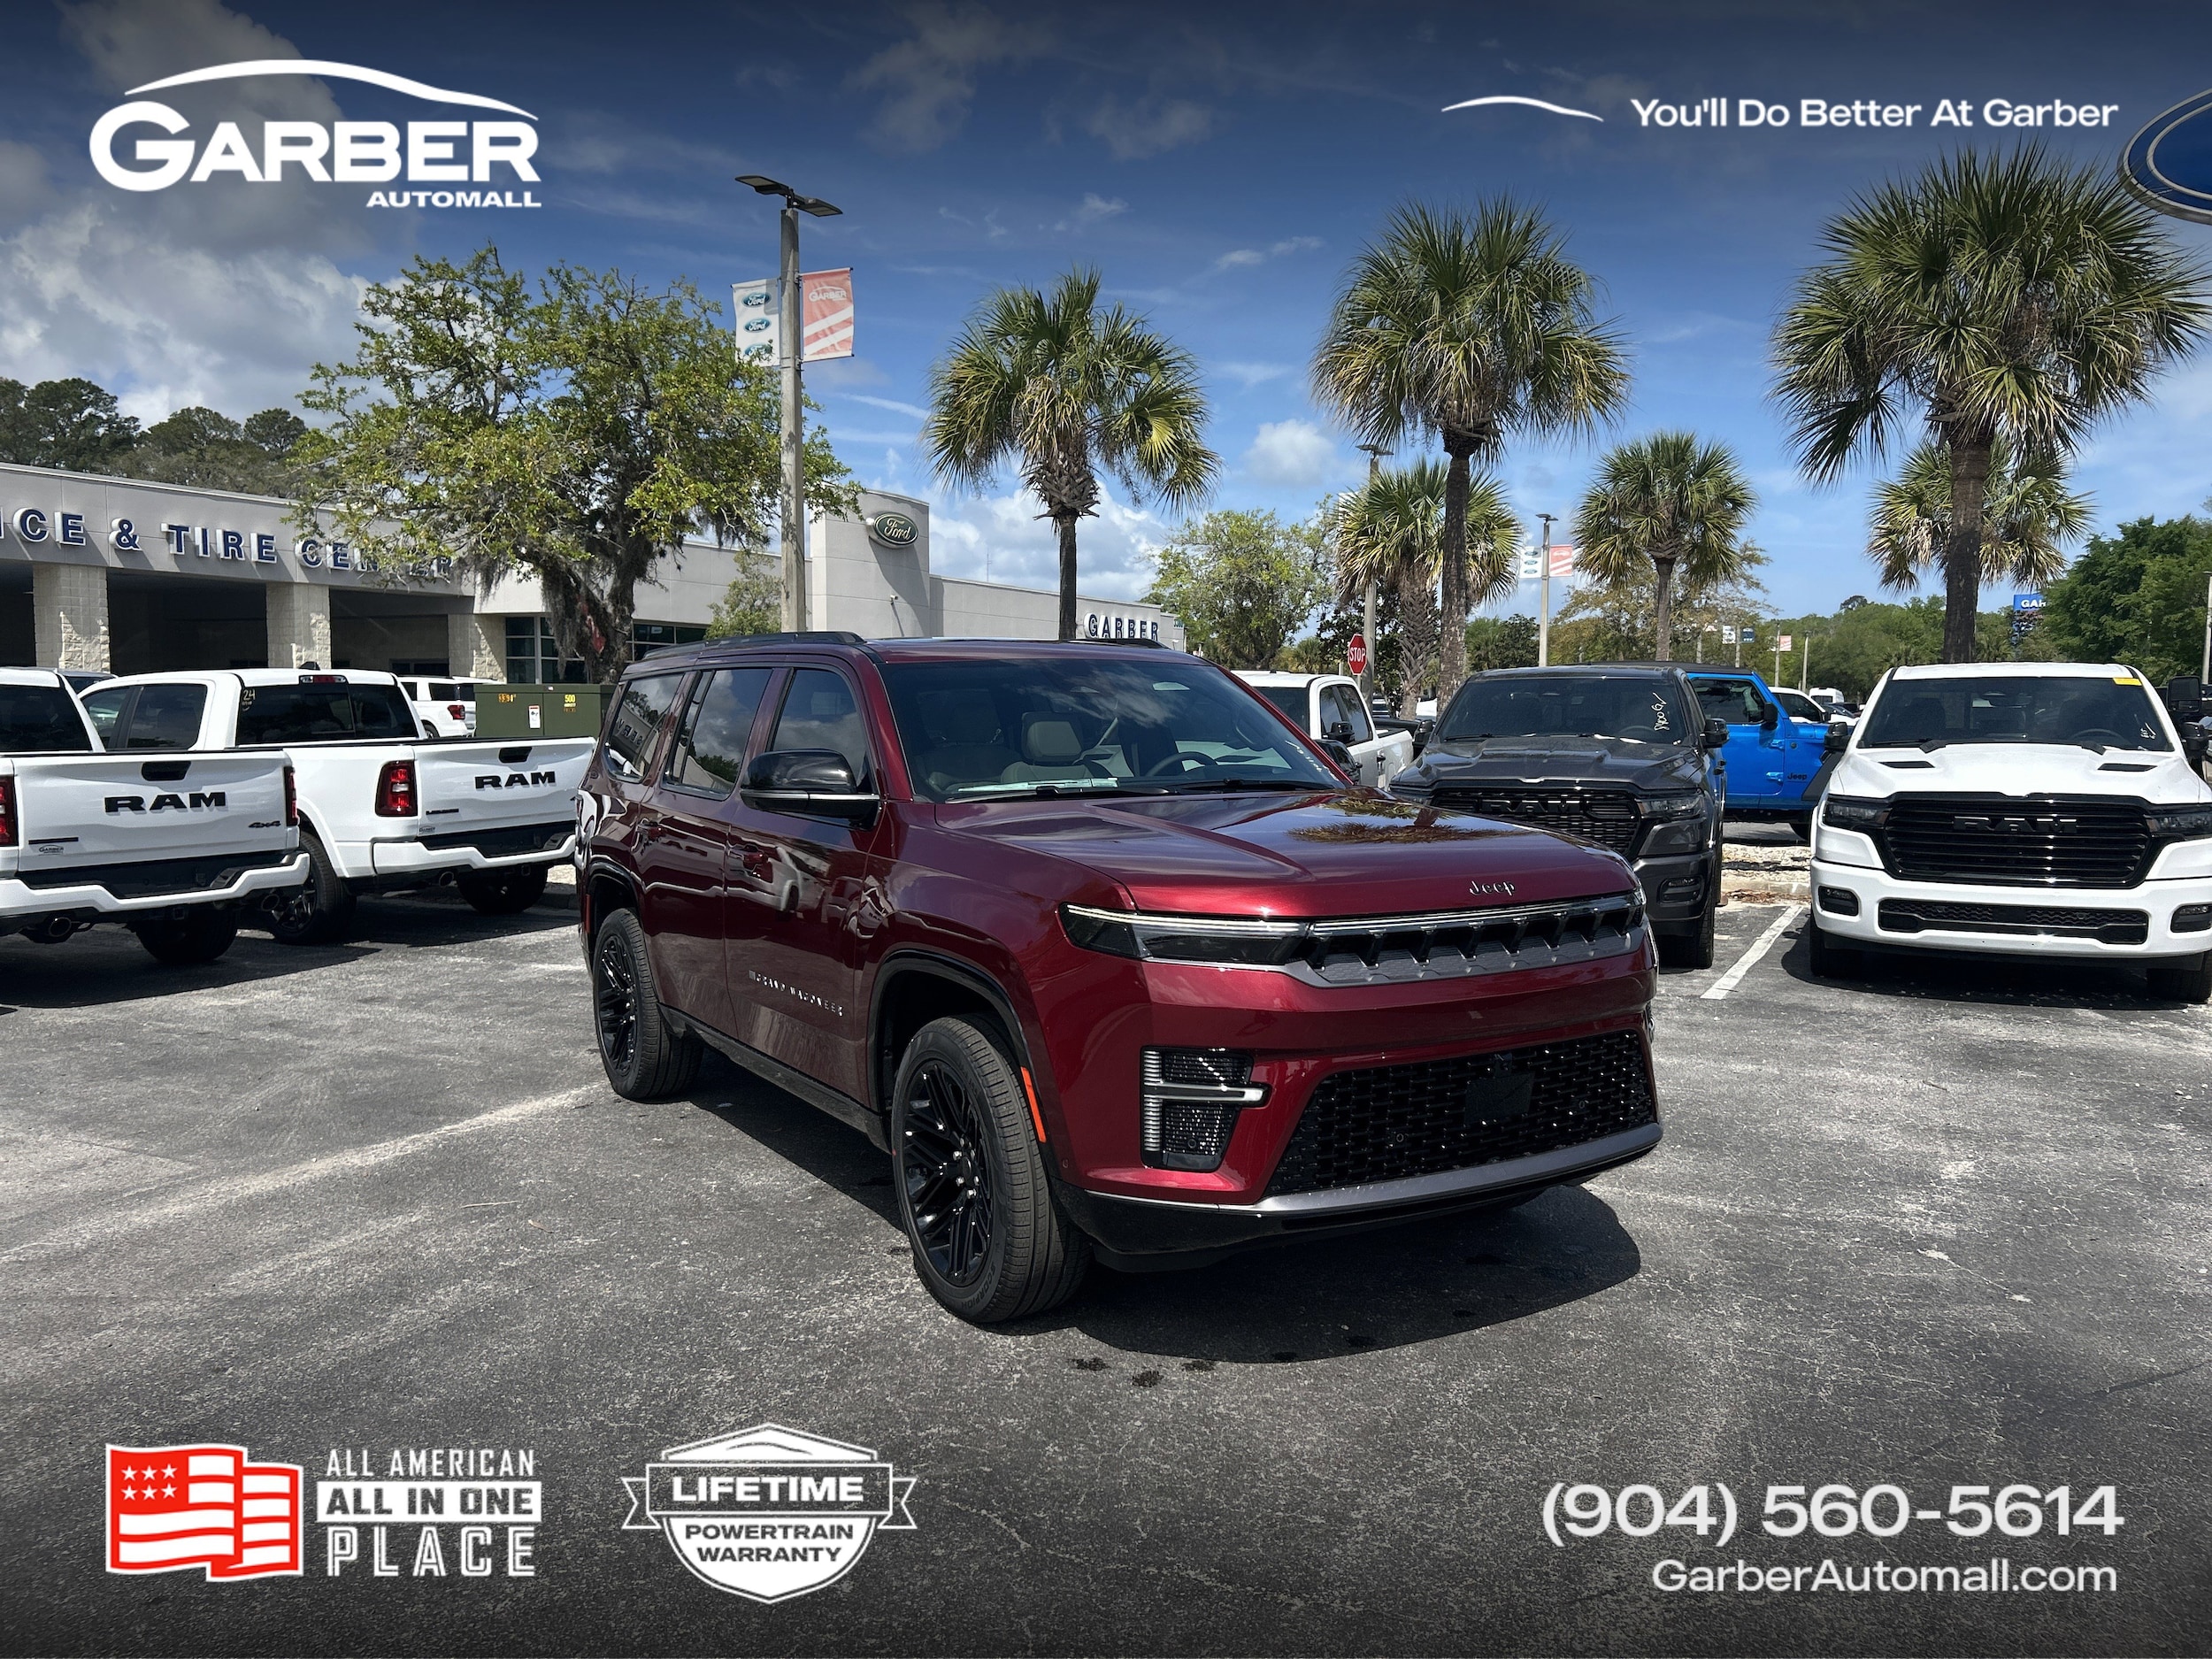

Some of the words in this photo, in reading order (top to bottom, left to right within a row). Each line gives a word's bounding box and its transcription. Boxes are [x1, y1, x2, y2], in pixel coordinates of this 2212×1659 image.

[884, 518, 911, 540] Ford
[109, 518, 142, 550] &
[161, 522, 278, 564] TIRE
[295, 539, 454, 577] CER
[1085, 612, 1159, 641] GARBER
[1349, 647, 1366, 663] STOP
[475, 771, 556, 790] RAM
[104, 791, 227, 814] RAM
[1953, 816, 2078, 833] RAM
[1469, 880, 1515, 896] Jeep
